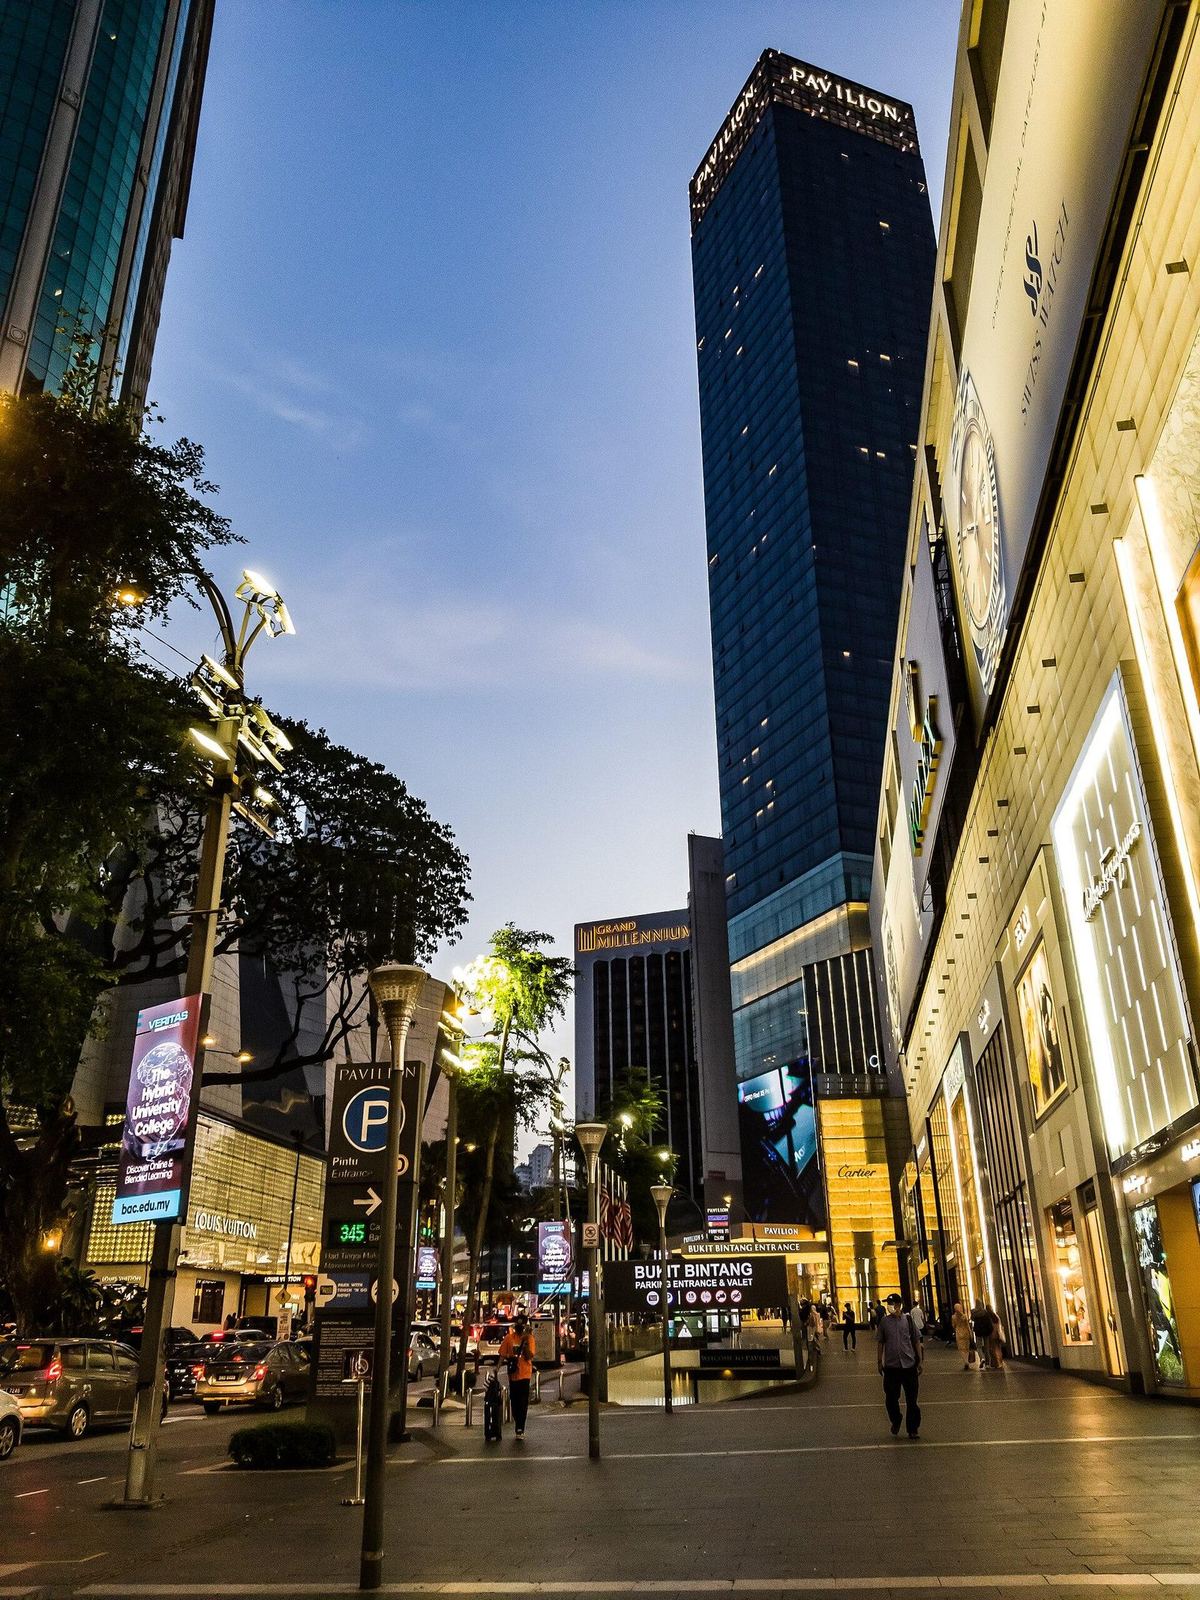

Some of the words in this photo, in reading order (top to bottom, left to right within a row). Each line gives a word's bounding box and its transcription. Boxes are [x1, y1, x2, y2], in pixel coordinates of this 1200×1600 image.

[791, 66, 899, 121] PAVILION
[695, 84, 755, 194] PAVILION
[596, 920, 637, 935] GRAND
[148, 1010, 189, 1030] VERITAS
[151, 1067, 171, 1082] The
[339, 1066, 416, 1081] PAVILIN
[142, 1082, 176, 1102] Hybrid
[132, 1098, 182, 1121] University
[134, 1117, 175, 1137] College
[361, 1100, 390, 1142] P
[332, 1156, 359, 1167] Pintu
[125, 1173, 148, 1185] Blended
[147, 1169, 173, 1182] Learning
[837, 1163, 878, 1179] Cartier
[121, 1199, 171, 1215] bac.edu.my
[194, 1211, 221, 1231] LOUIS
[221, 1219, 257, 1239] VUITTON
[340, 1224, 365, 1242] 345
[764, 1227, 799, 1235] PAVILION
[688, 1244, 714, 1253] BUKIT
[715, 1244, 753, 1252] BINTANG
[754, 1243, 800, 1251] ENTRANCE
[684, 1262, 753, 1278] BINTANG
[673, 1279, 717, 1288] ENTRANCE
[719, 1279, 725, 1287] &
[726, 1278, 753, 1287] VALET
